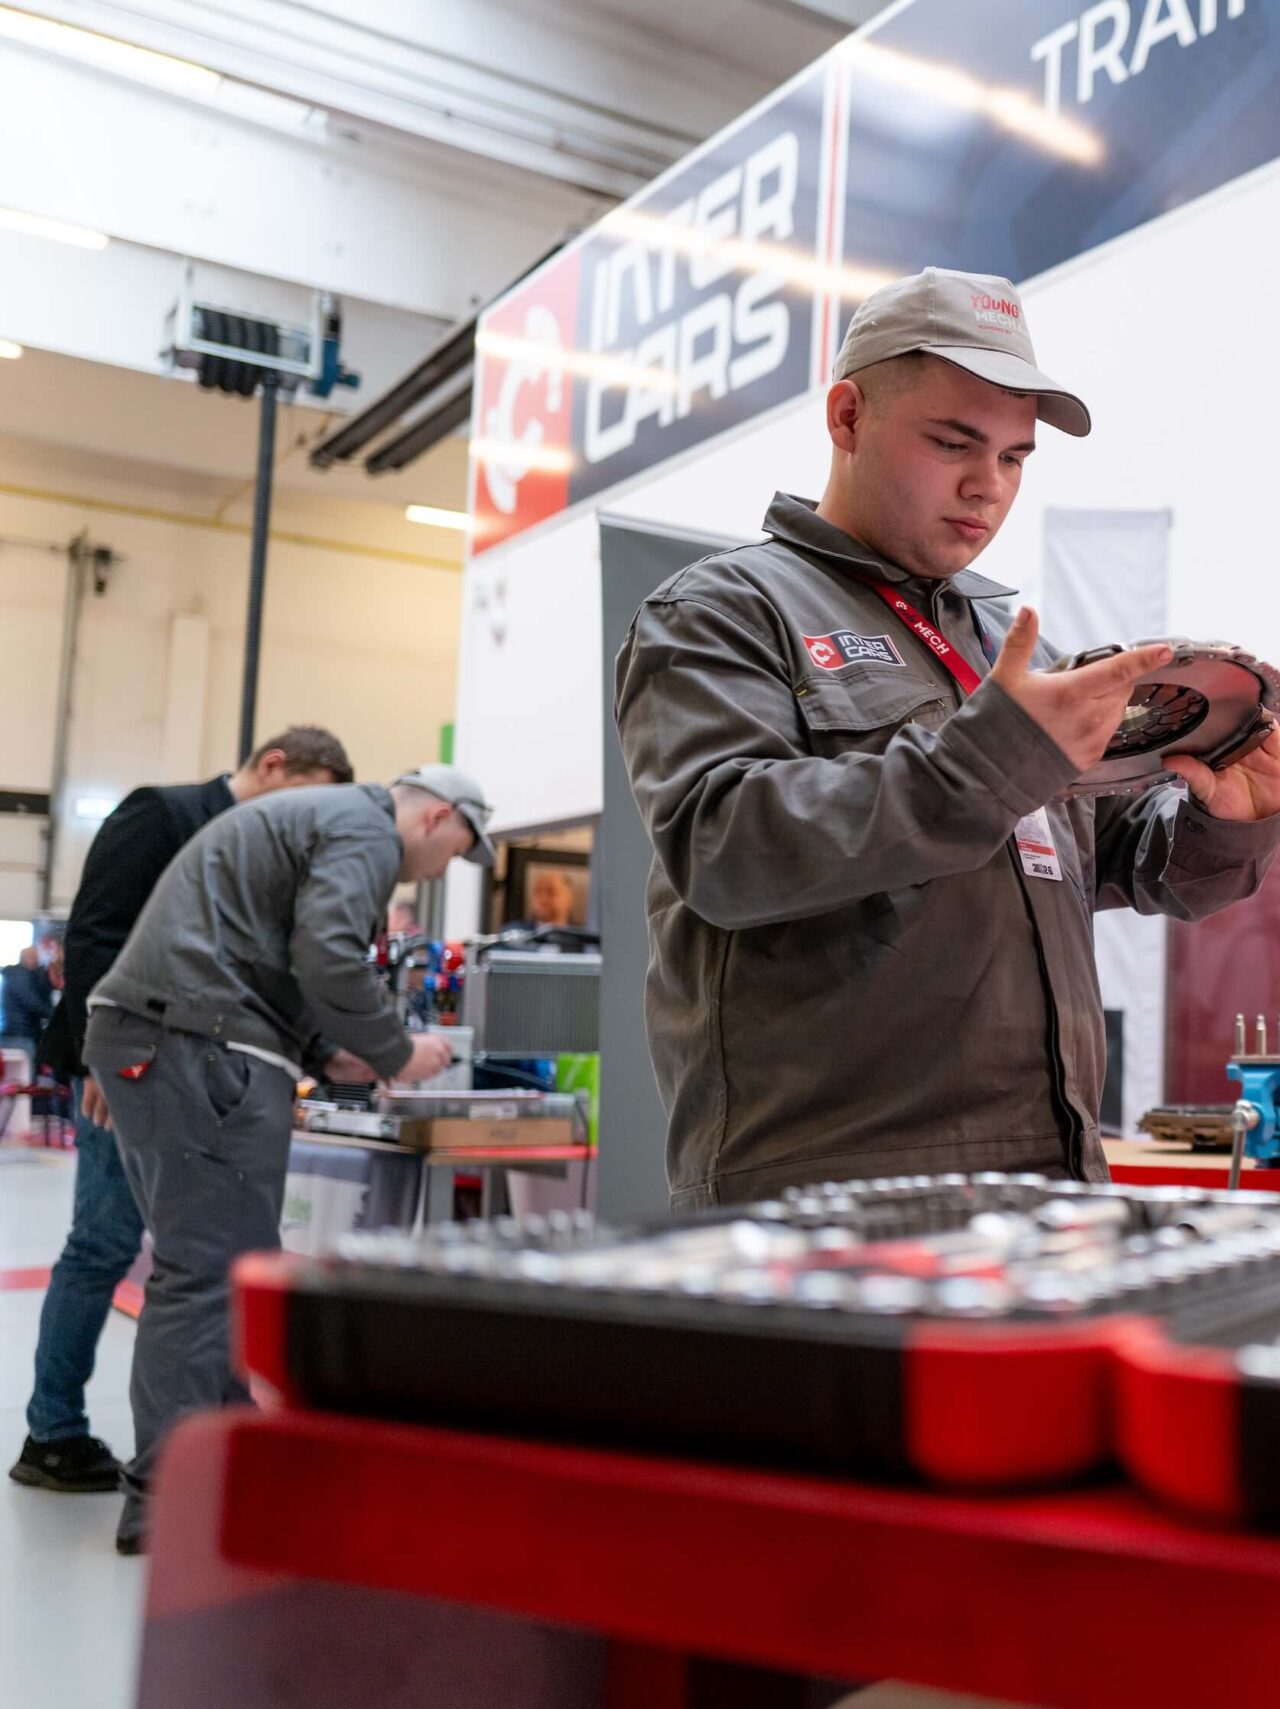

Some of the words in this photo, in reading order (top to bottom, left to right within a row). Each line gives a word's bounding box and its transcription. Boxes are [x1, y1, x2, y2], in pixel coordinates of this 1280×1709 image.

[1030, 0, 1245, 122] TRAI
[591, 131, 799, 346] INTER
[585, 267, 790, 464] CARS
[838, 635, 887, 652] INTER
[845, 646, 894, 662] CARS
[914, 621, 950, 655] MECH
